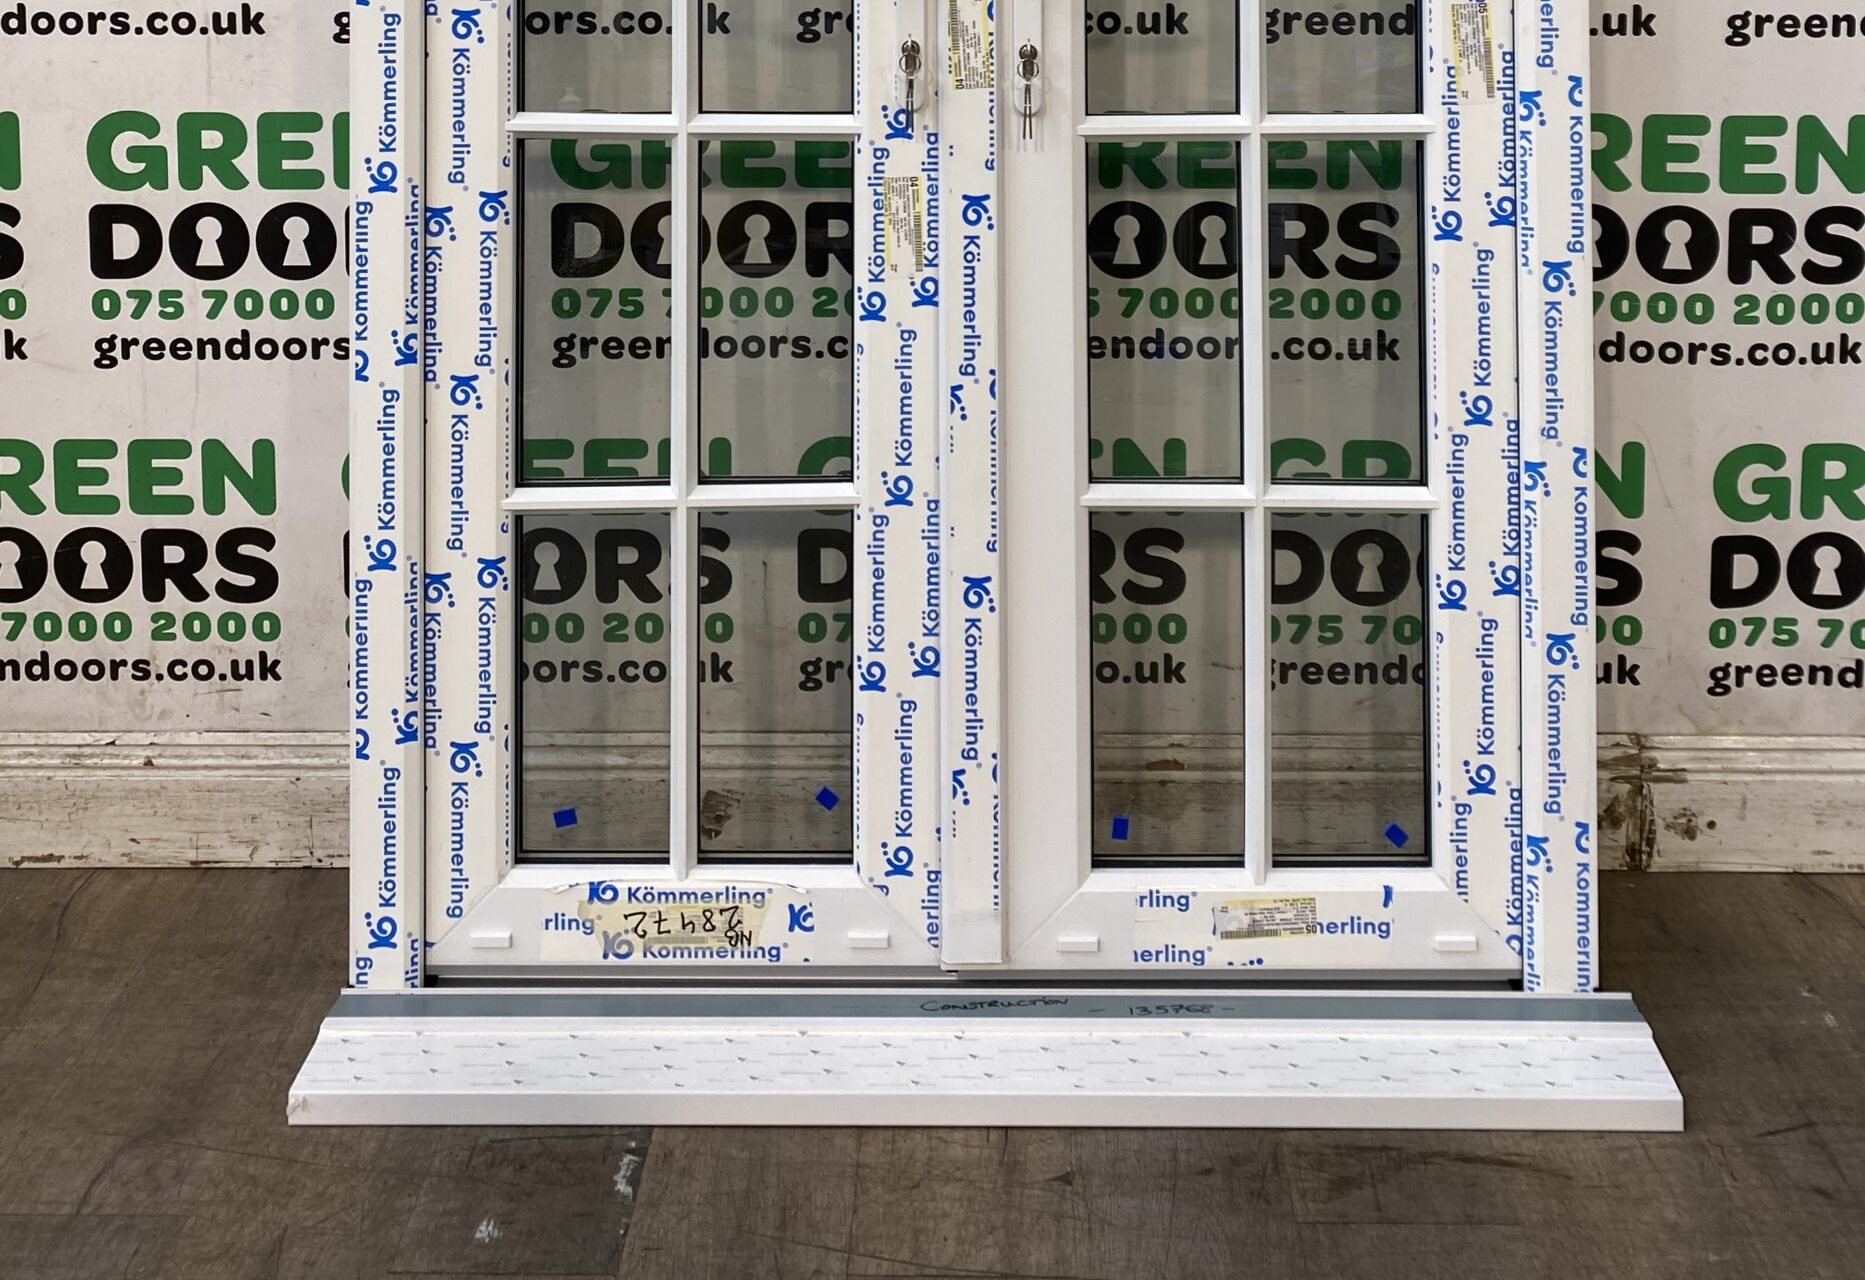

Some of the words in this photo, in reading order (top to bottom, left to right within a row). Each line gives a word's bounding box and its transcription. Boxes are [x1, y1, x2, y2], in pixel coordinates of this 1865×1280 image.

[955, 79, 964, 89] 04
[910, 177, 918, 187] 04
[92, 289, 184, 320] 075
[202, 289, 334, 320] 7000
[552, 288, 644, 319] 075
[1269, 288, 1401, 320] 2000
[151, 612, 281, 642] 2000
[1709, 617, 1798, 648] 075
